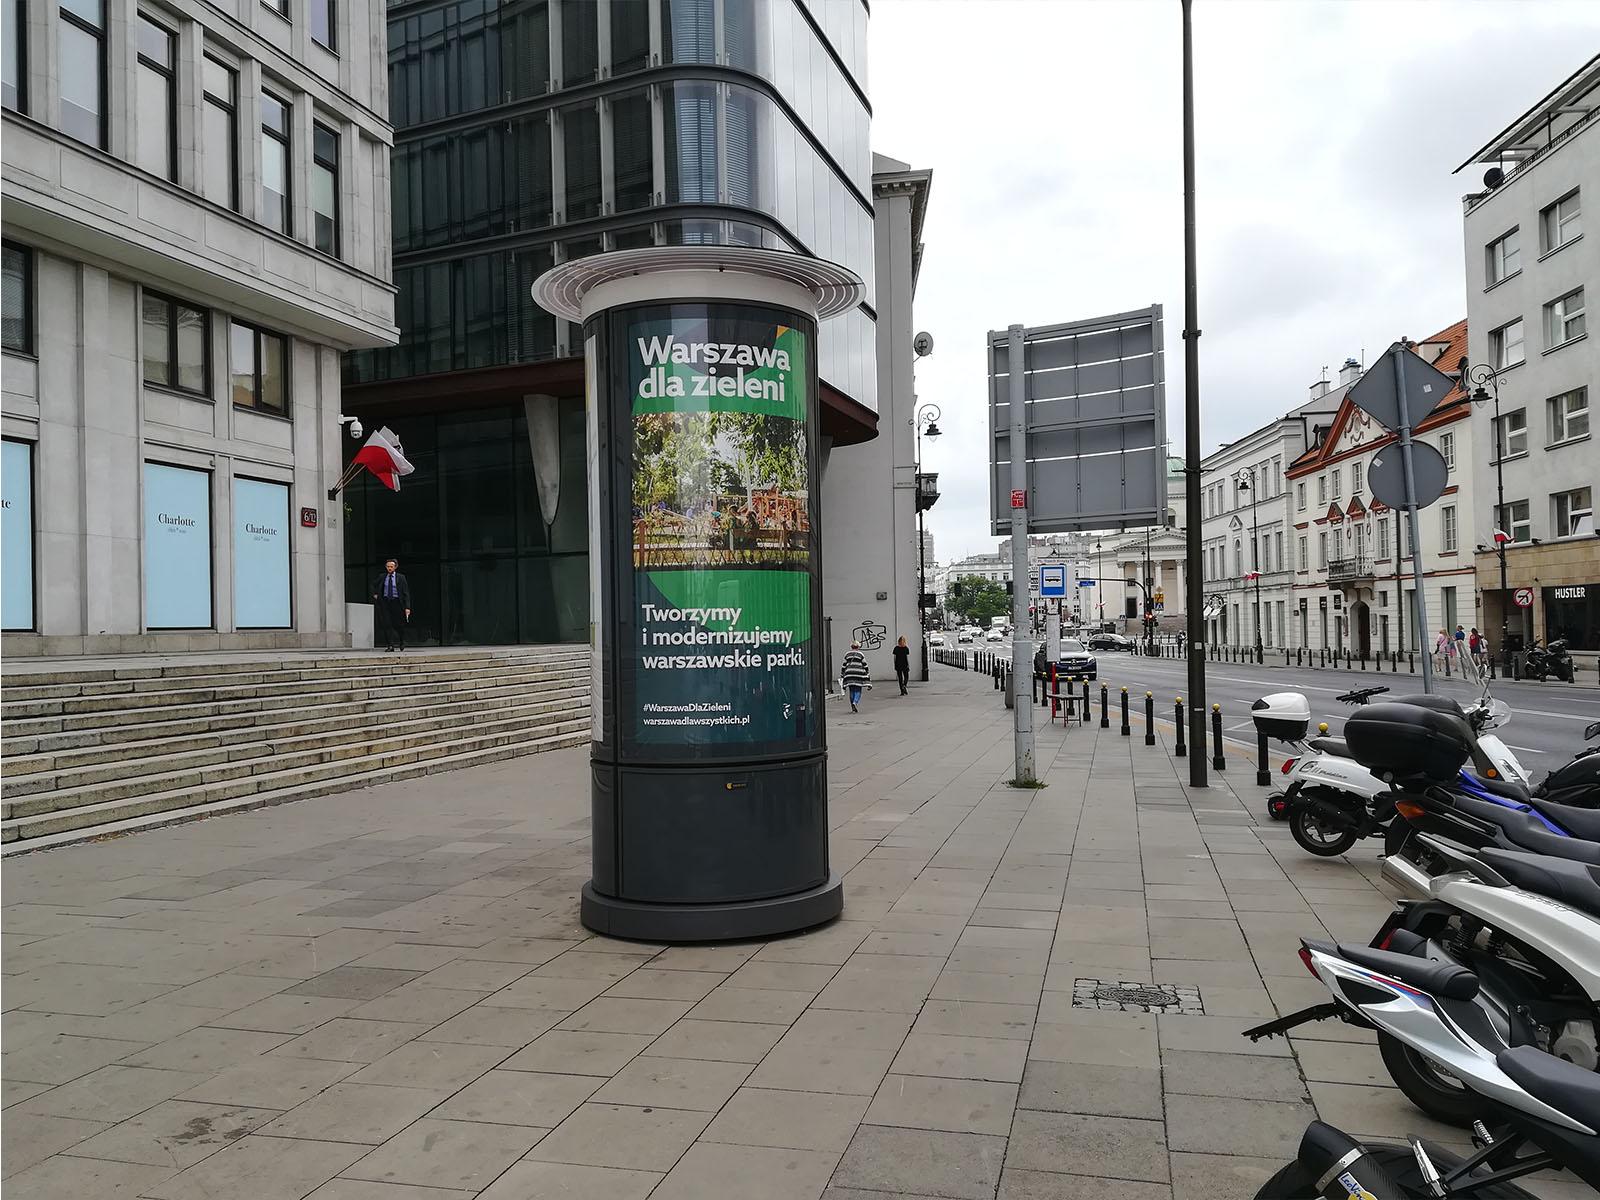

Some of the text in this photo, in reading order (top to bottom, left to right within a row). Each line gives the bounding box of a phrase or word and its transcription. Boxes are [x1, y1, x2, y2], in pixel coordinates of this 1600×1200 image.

[637, 334, 792, 372] Warszawa
[638, 366, 785, 402] dla zieleni
[158, 512, 196, 527] Charlotte
[245, 522, 278, 536] Charlotte
[1554, 586, 1586, 599] HUSTLER
[641, 603, 742, 626] Tworzymy
[642, 625, 793, 649] i modernizujemy
[642, 647, 805, 672] warszawskie parki.
[643, 702, 731, 713] #WarszawaDlaZieleni
[643, 714, 750, 727] warszawadlawszystkich.pl
